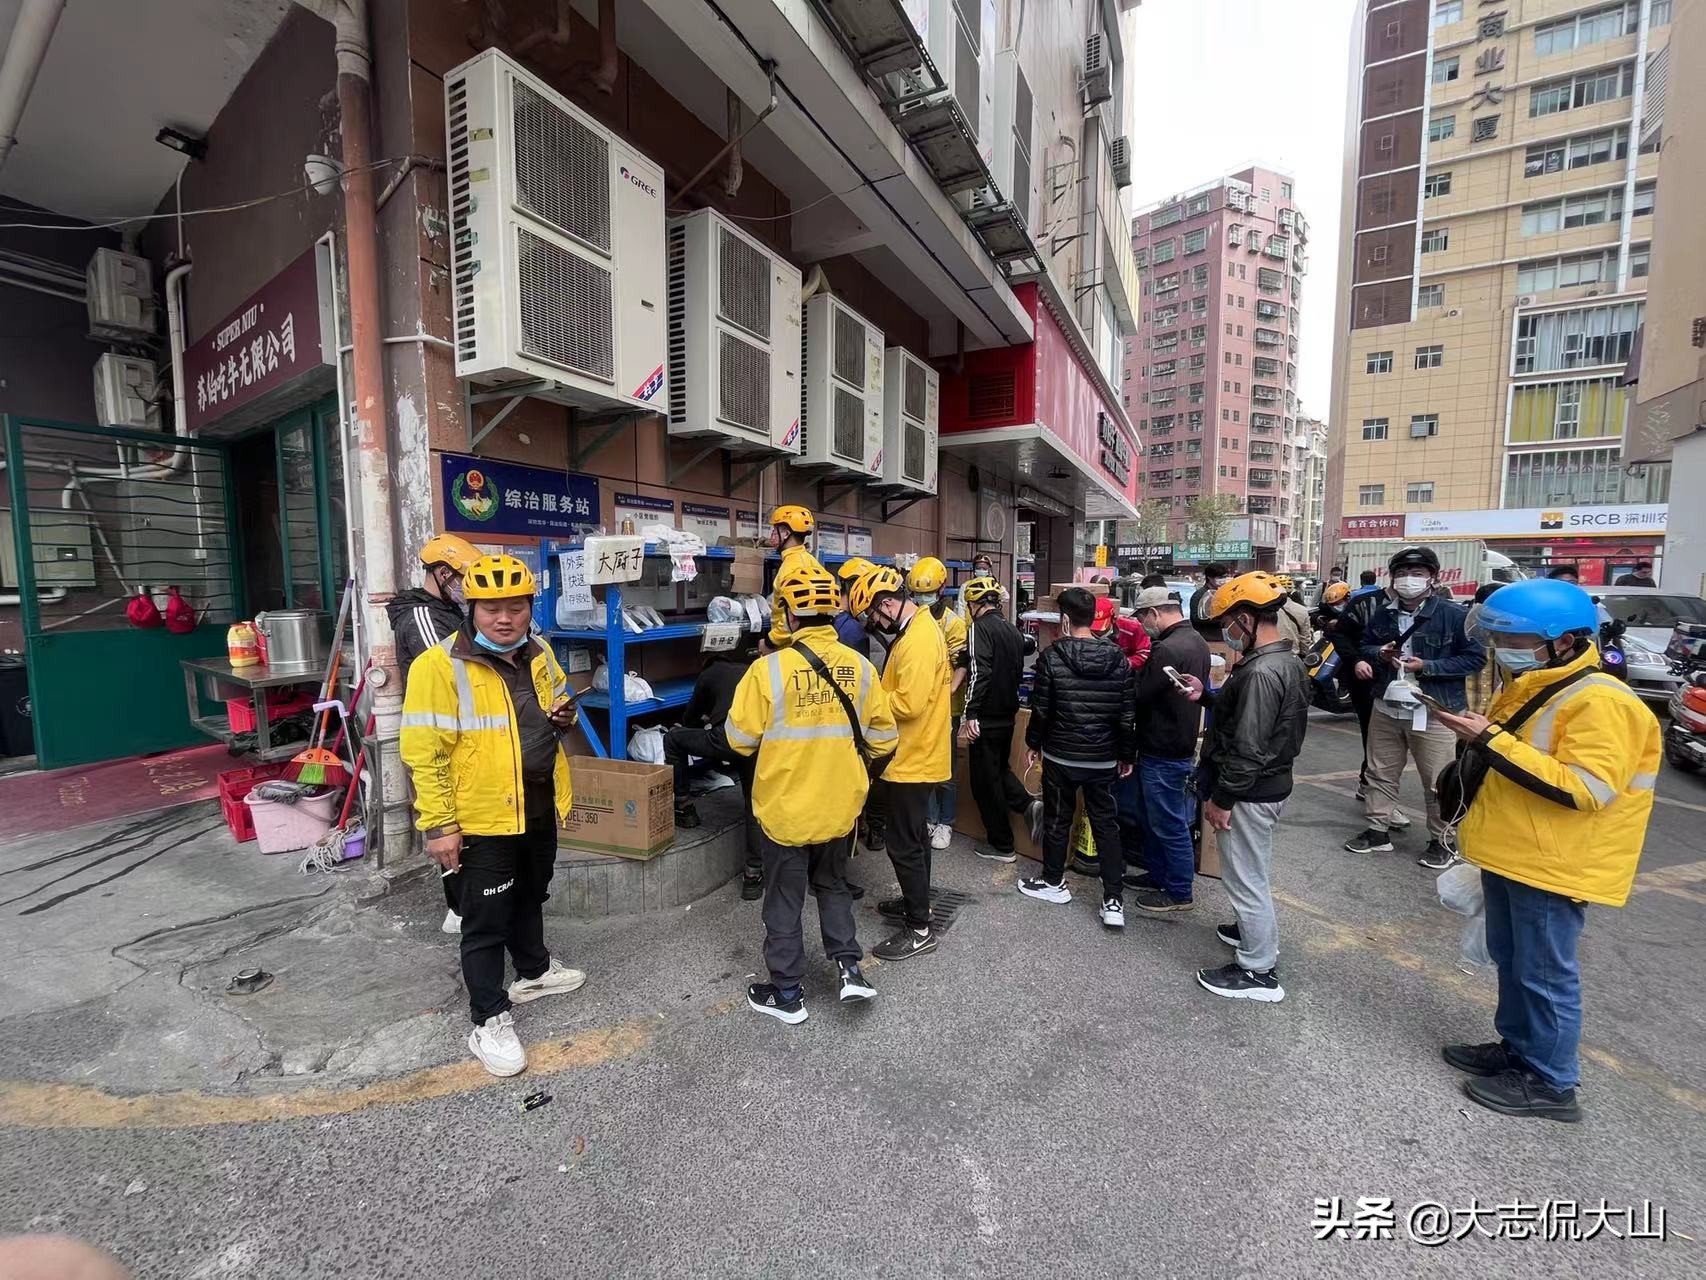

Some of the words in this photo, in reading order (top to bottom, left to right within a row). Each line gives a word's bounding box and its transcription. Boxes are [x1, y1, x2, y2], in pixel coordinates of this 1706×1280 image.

[1470, 0, 1508, 143] 商业大厦
[631, 175, 657, 199] GREE
[217, 318, 241, 352] SUPER
[241, 304, 258, 334] NIU
[504, 488, 590, 516] 综治服务站
[1347, 519, 1399, 529] 鑫百合休闲
[1569, 513, 1621, 526] SRCB
[566, 555, 585, 570] 外卖
[598, 547, 643, 575] 大厨子
[585, 812, 599, 825] 350
[483, 888, 497, 896] OH
